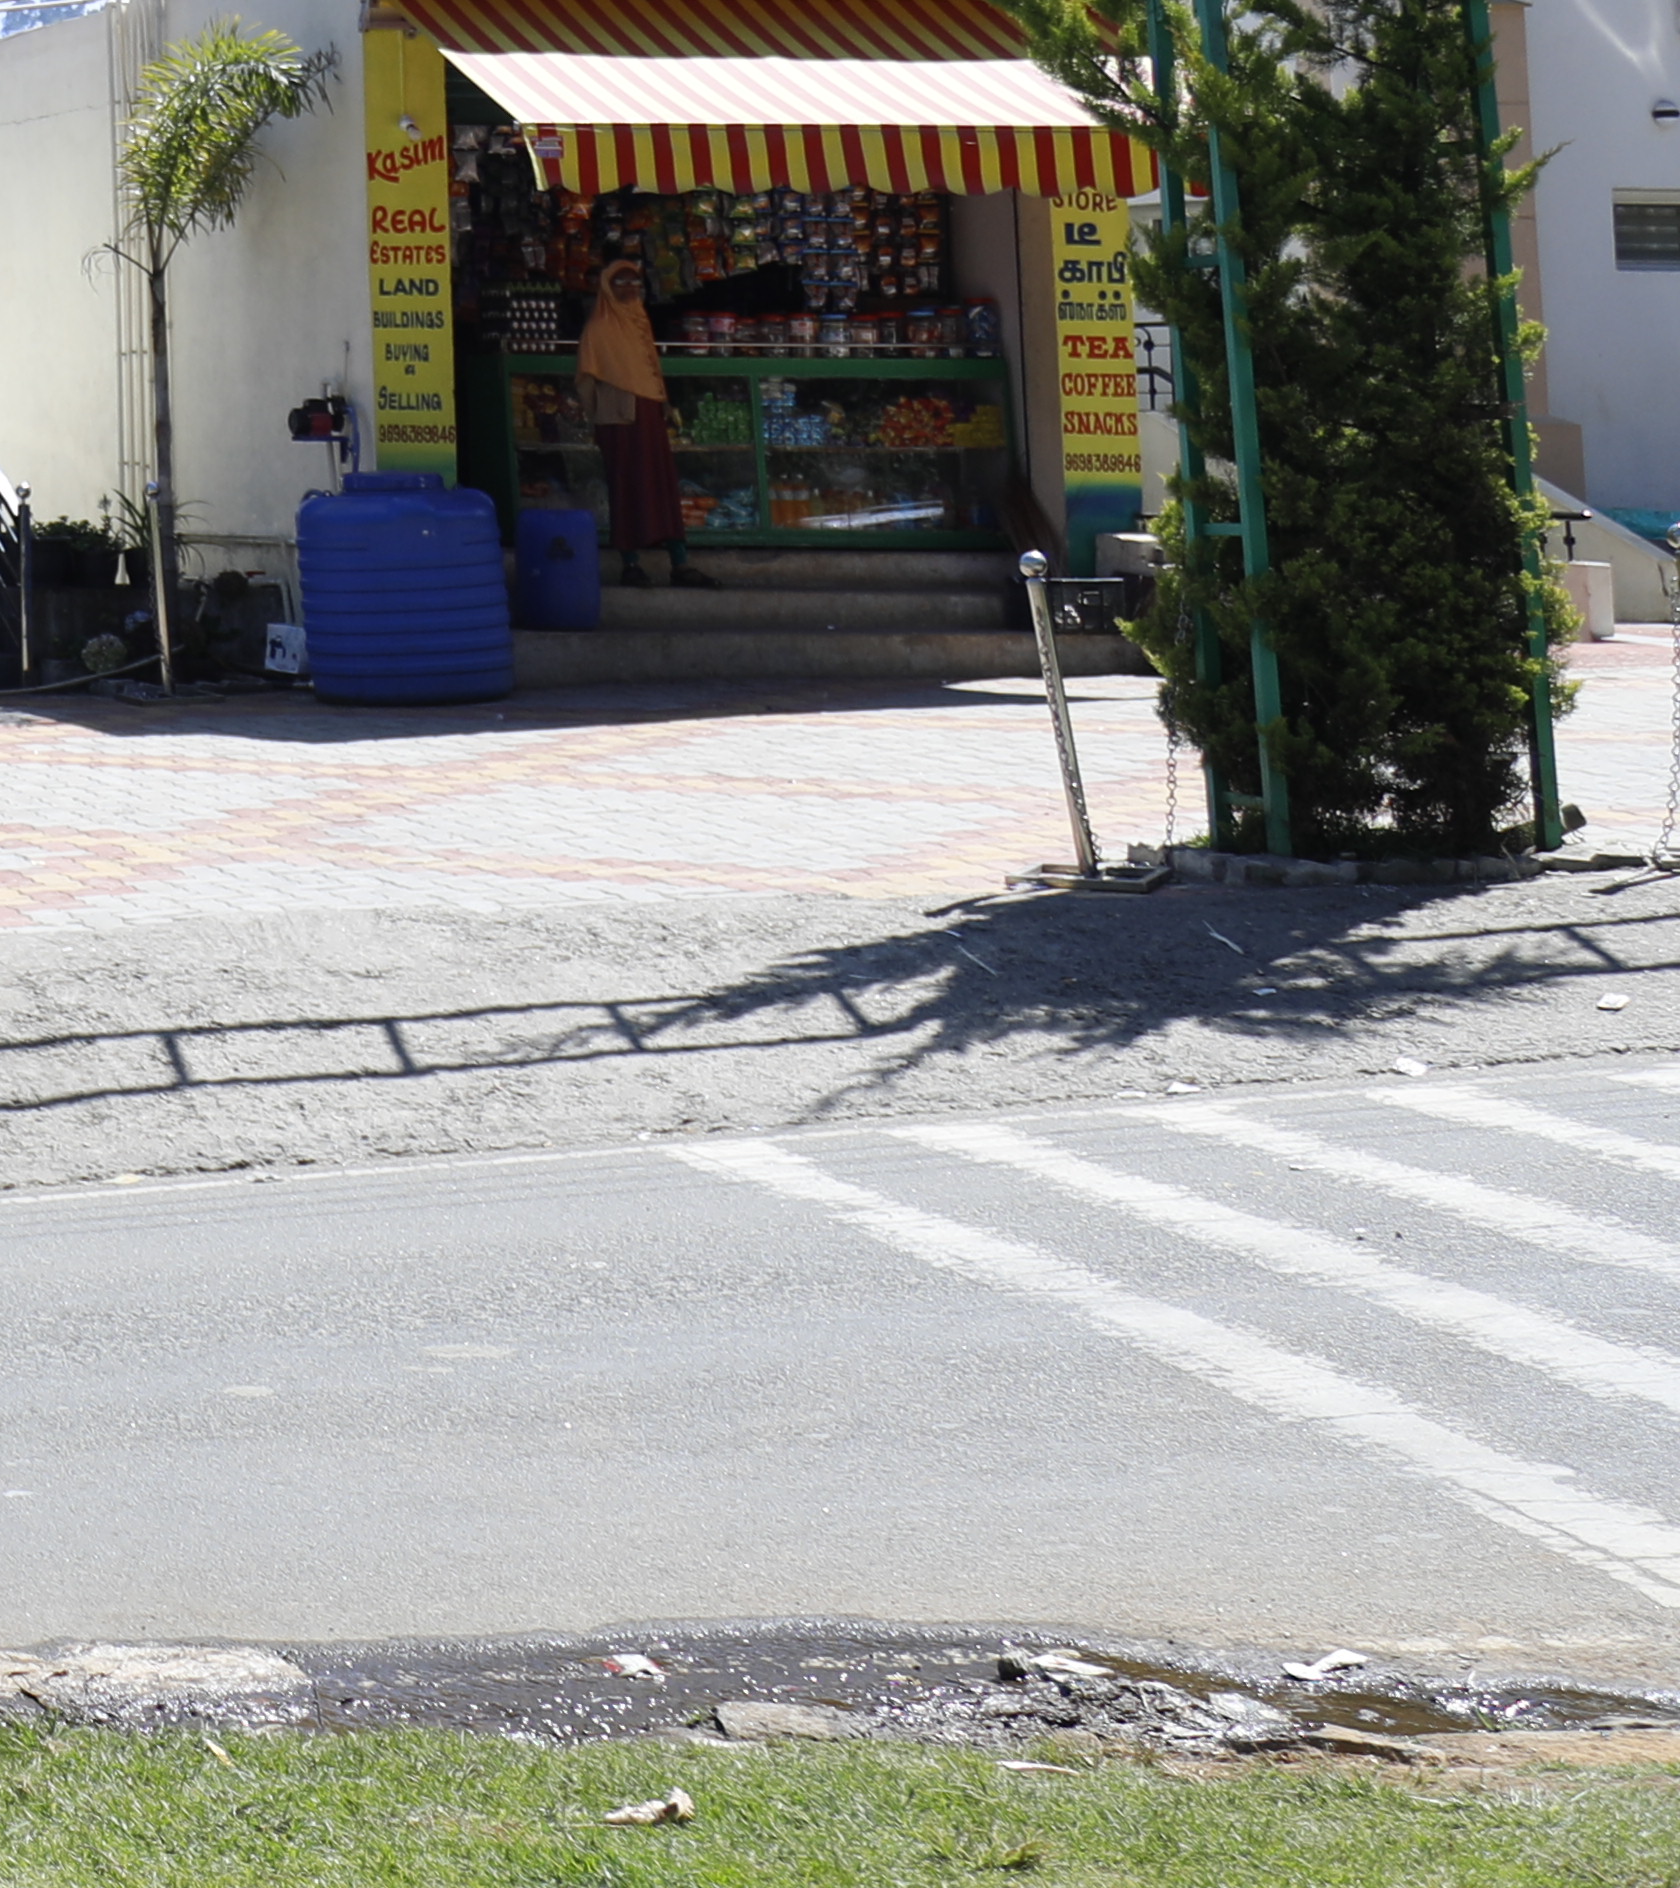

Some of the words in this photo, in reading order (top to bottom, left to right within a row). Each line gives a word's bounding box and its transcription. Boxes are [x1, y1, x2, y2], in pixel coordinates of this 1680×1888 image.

[371, 205, 447, 234] REAL
[370, 241, 447, 265] ESTATES
[378, 278, 440, 296] LAND
[373, 310, 445, 329] BUILDINGS
[384, 343, 430, 362] BUYING
[1062, 334, 1134, 359] TEA
[1061, 372, 1137, 397] COFFEE
[378, 386, 442, 411] SELLING
[1063, 410, 1138, 436] SNACKS
